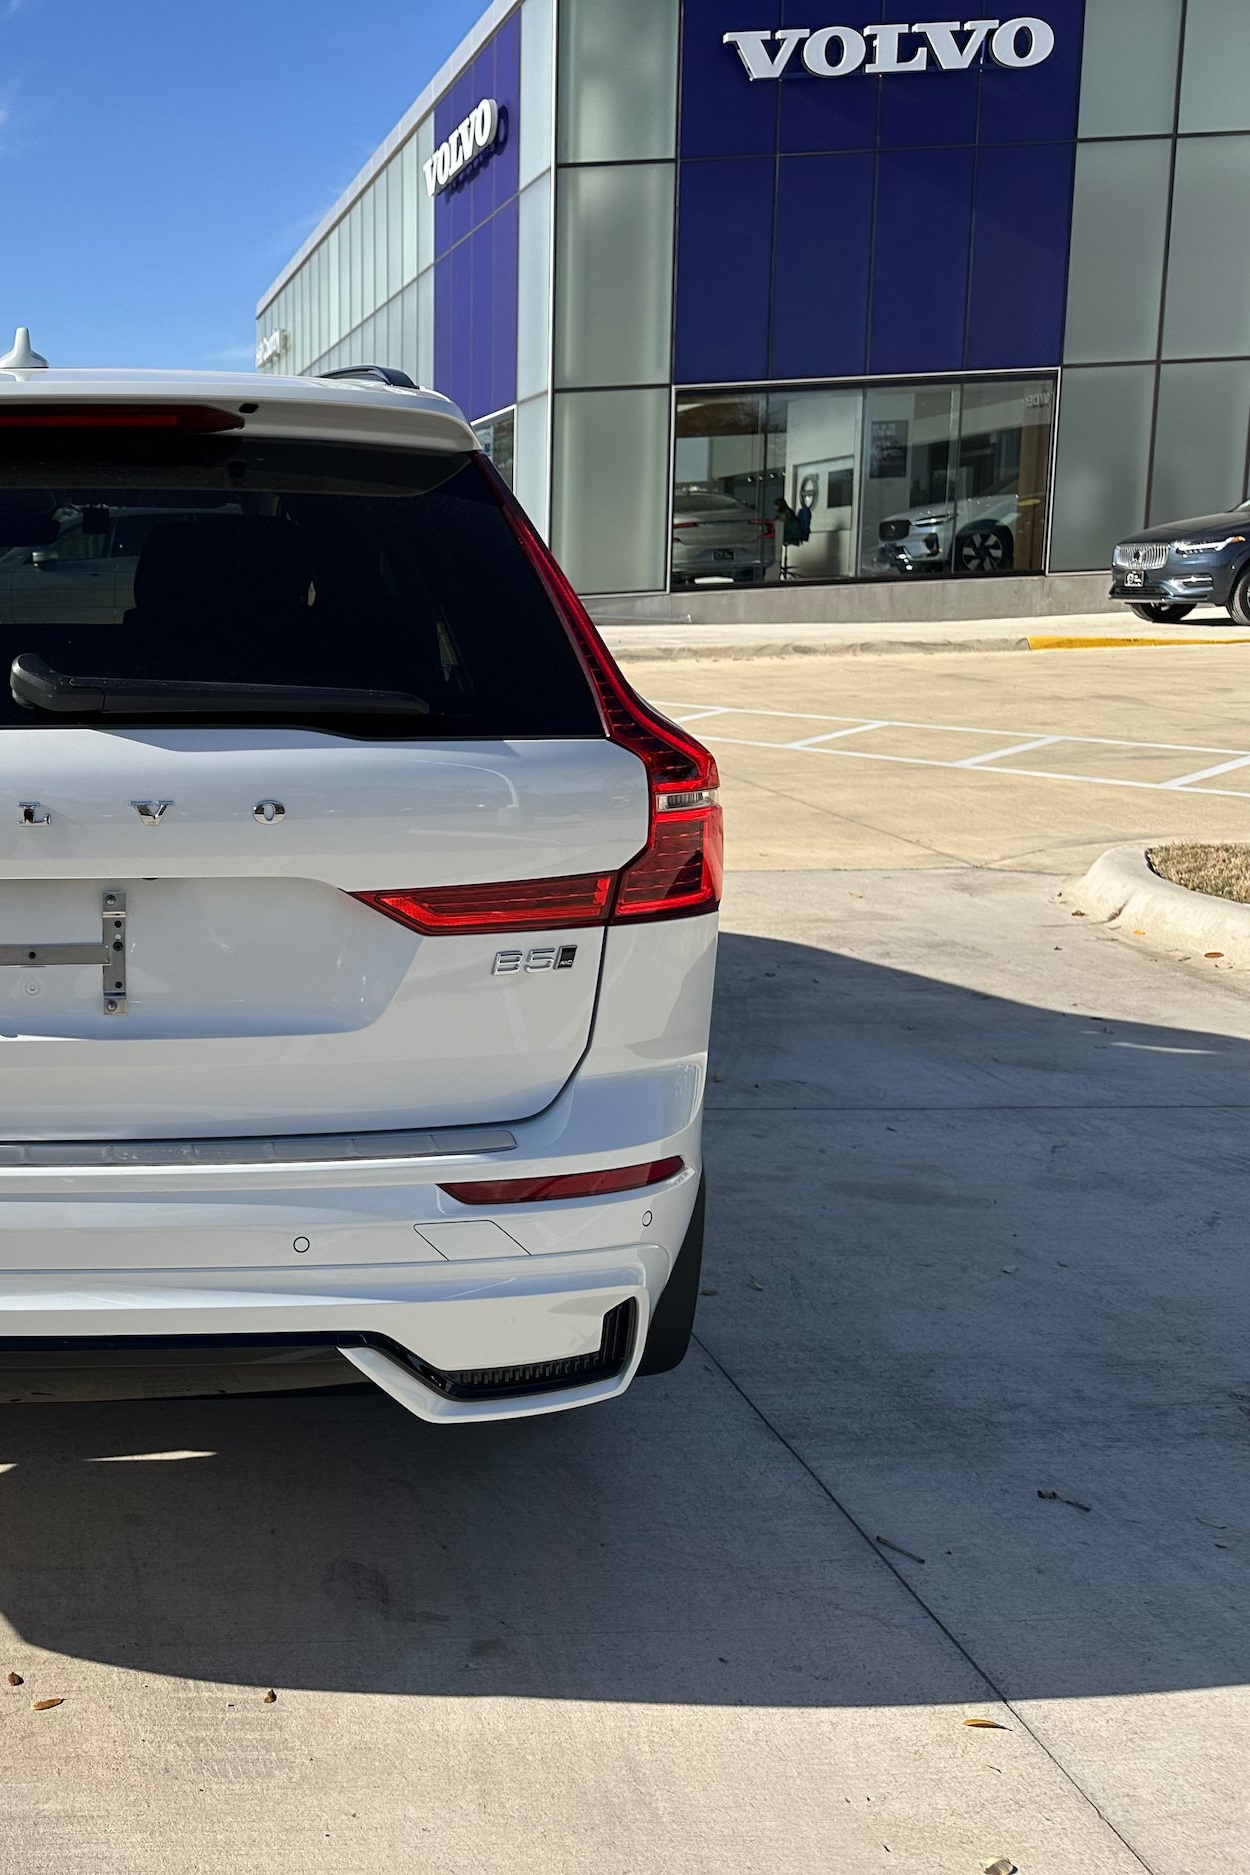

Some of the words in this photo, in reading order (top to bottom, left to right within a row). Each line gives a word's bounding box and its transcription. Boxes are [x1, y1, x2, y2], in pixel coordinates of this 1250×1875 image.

[723, 16, 1055, 80] VOLVO
[422, 98, 498, 197] VOLVO
[490, 947, 556, 976] B5
